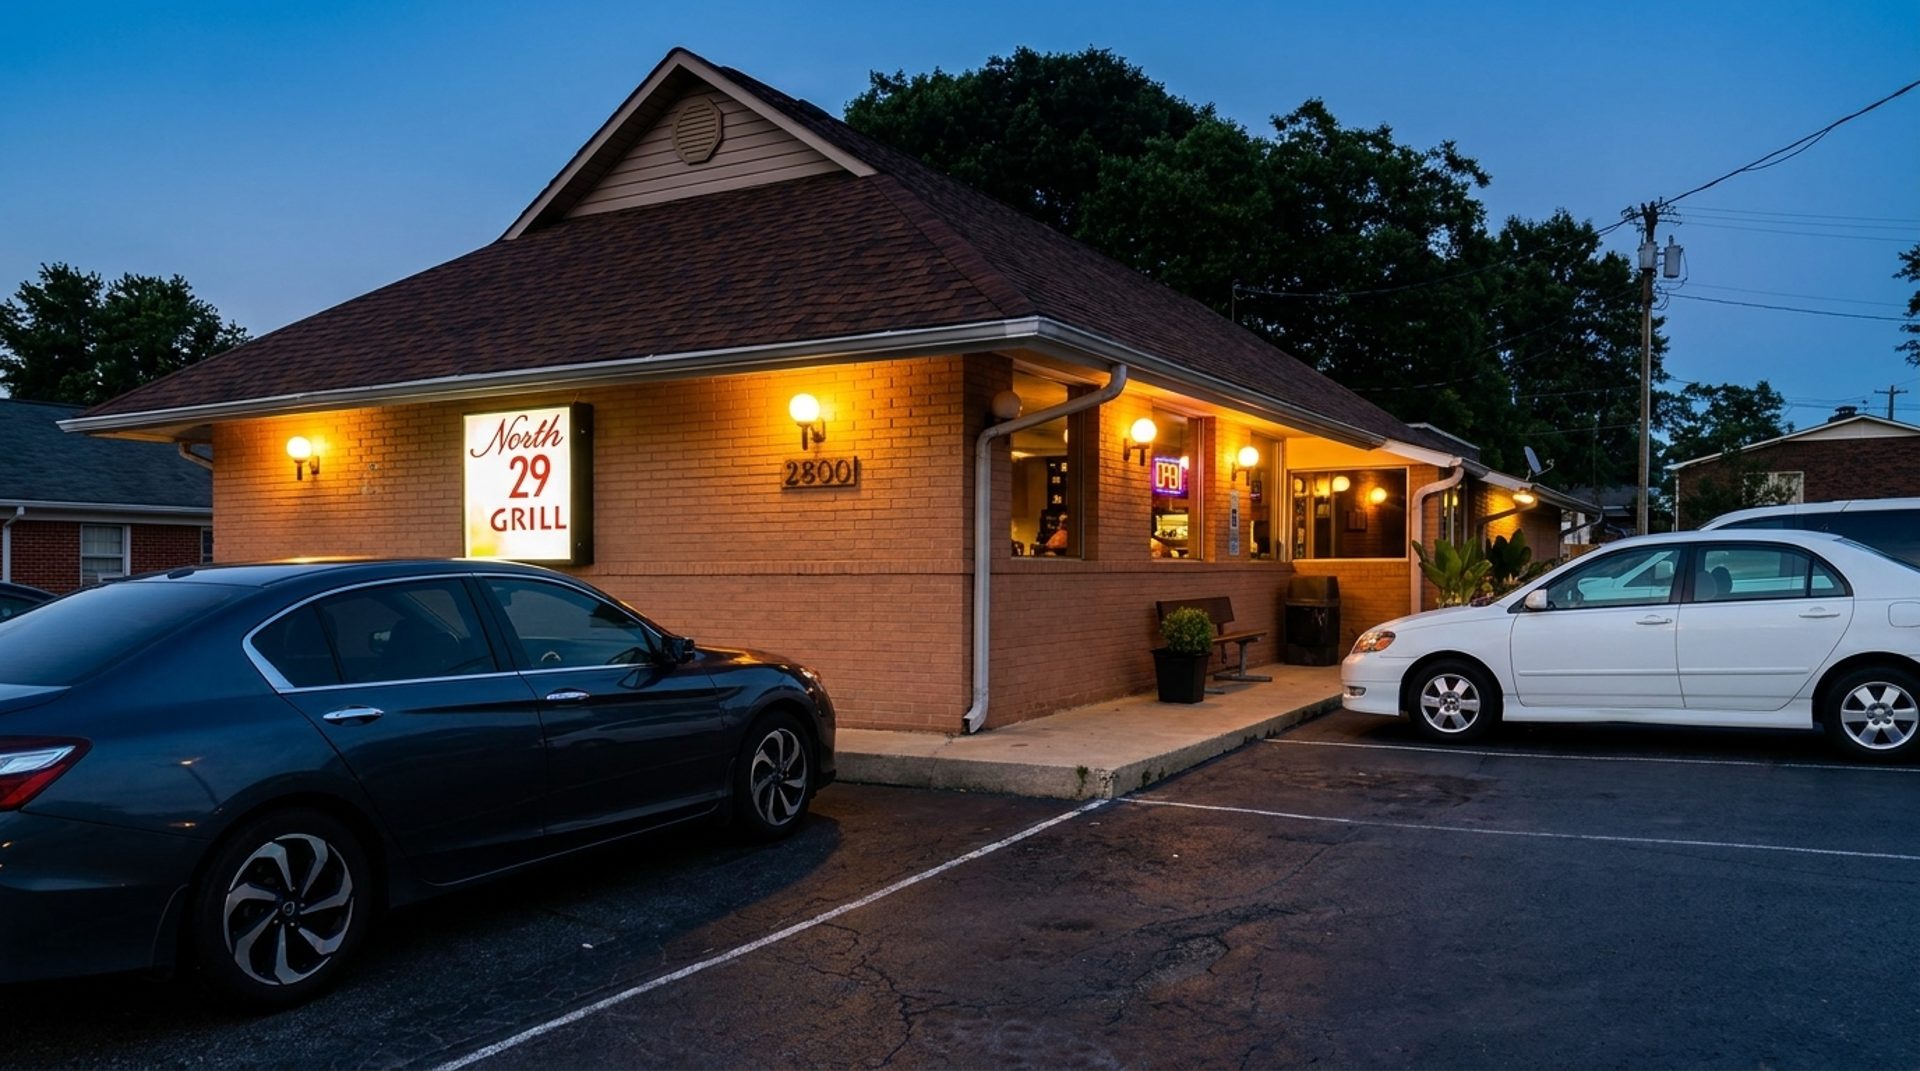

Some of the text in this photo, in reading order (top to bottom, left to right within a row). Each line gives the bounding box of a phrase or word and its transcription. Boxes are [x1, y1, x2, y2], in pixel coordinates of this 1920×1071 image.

[470, 414, 563, 458] North
[508, 454, 551, 499] 29
[785, 459, 851, 486] 2800
[490, 506, 567, 532] GRILL
